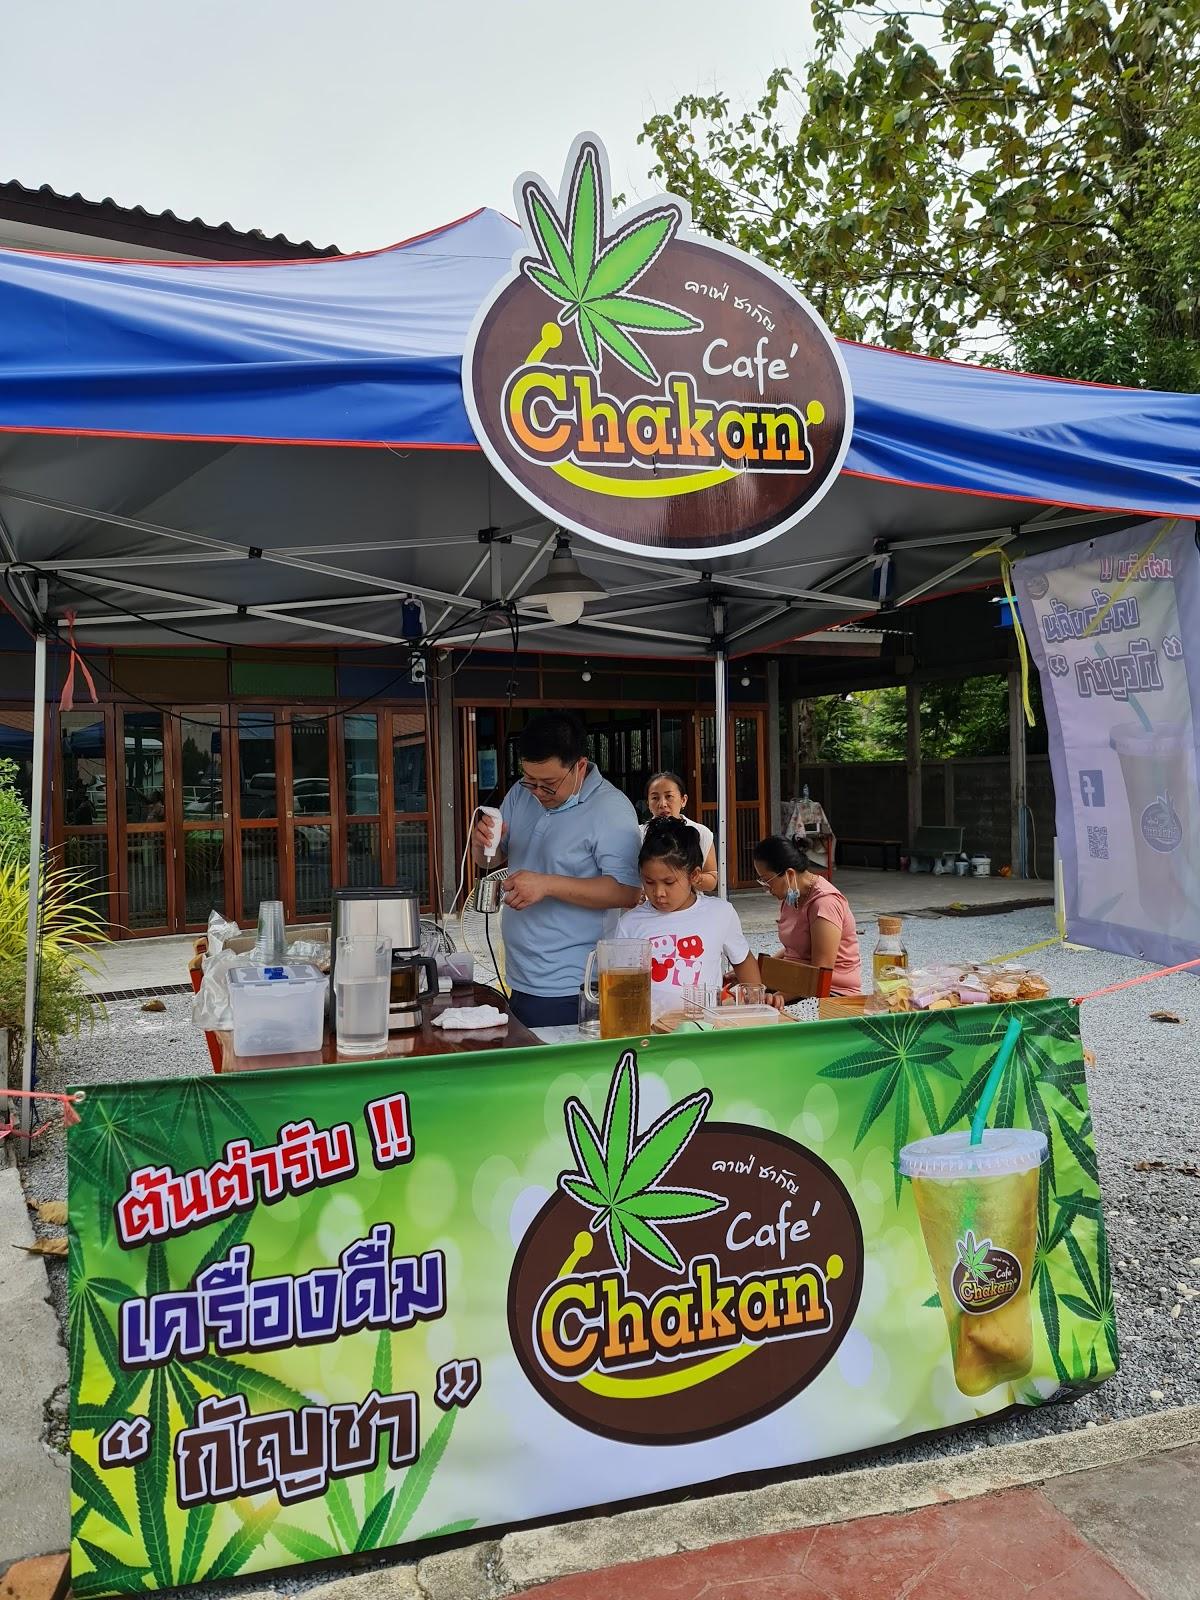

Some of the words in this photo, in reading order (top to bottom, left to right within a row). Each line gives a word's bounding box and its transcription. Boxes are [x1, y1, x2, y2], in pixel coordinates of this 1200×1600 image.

[684, 281, 730, 301] คาเฟ่
[733, 296, 776, 332] ชากัญ
[506, 368, 809, 468] Chakan
[119, 1119, 353, 1244] ต้นตำรับ
[711, 1154, 756, 1175] คาเฟ่
[758, 1165, 800, 1195] ชากัญ
[121, 1224, 445, 1365] เครื่องดื่ม
[537, 1260, 828, 1374] Chakan
[178, 1391, 418, 1502] กัญชา
